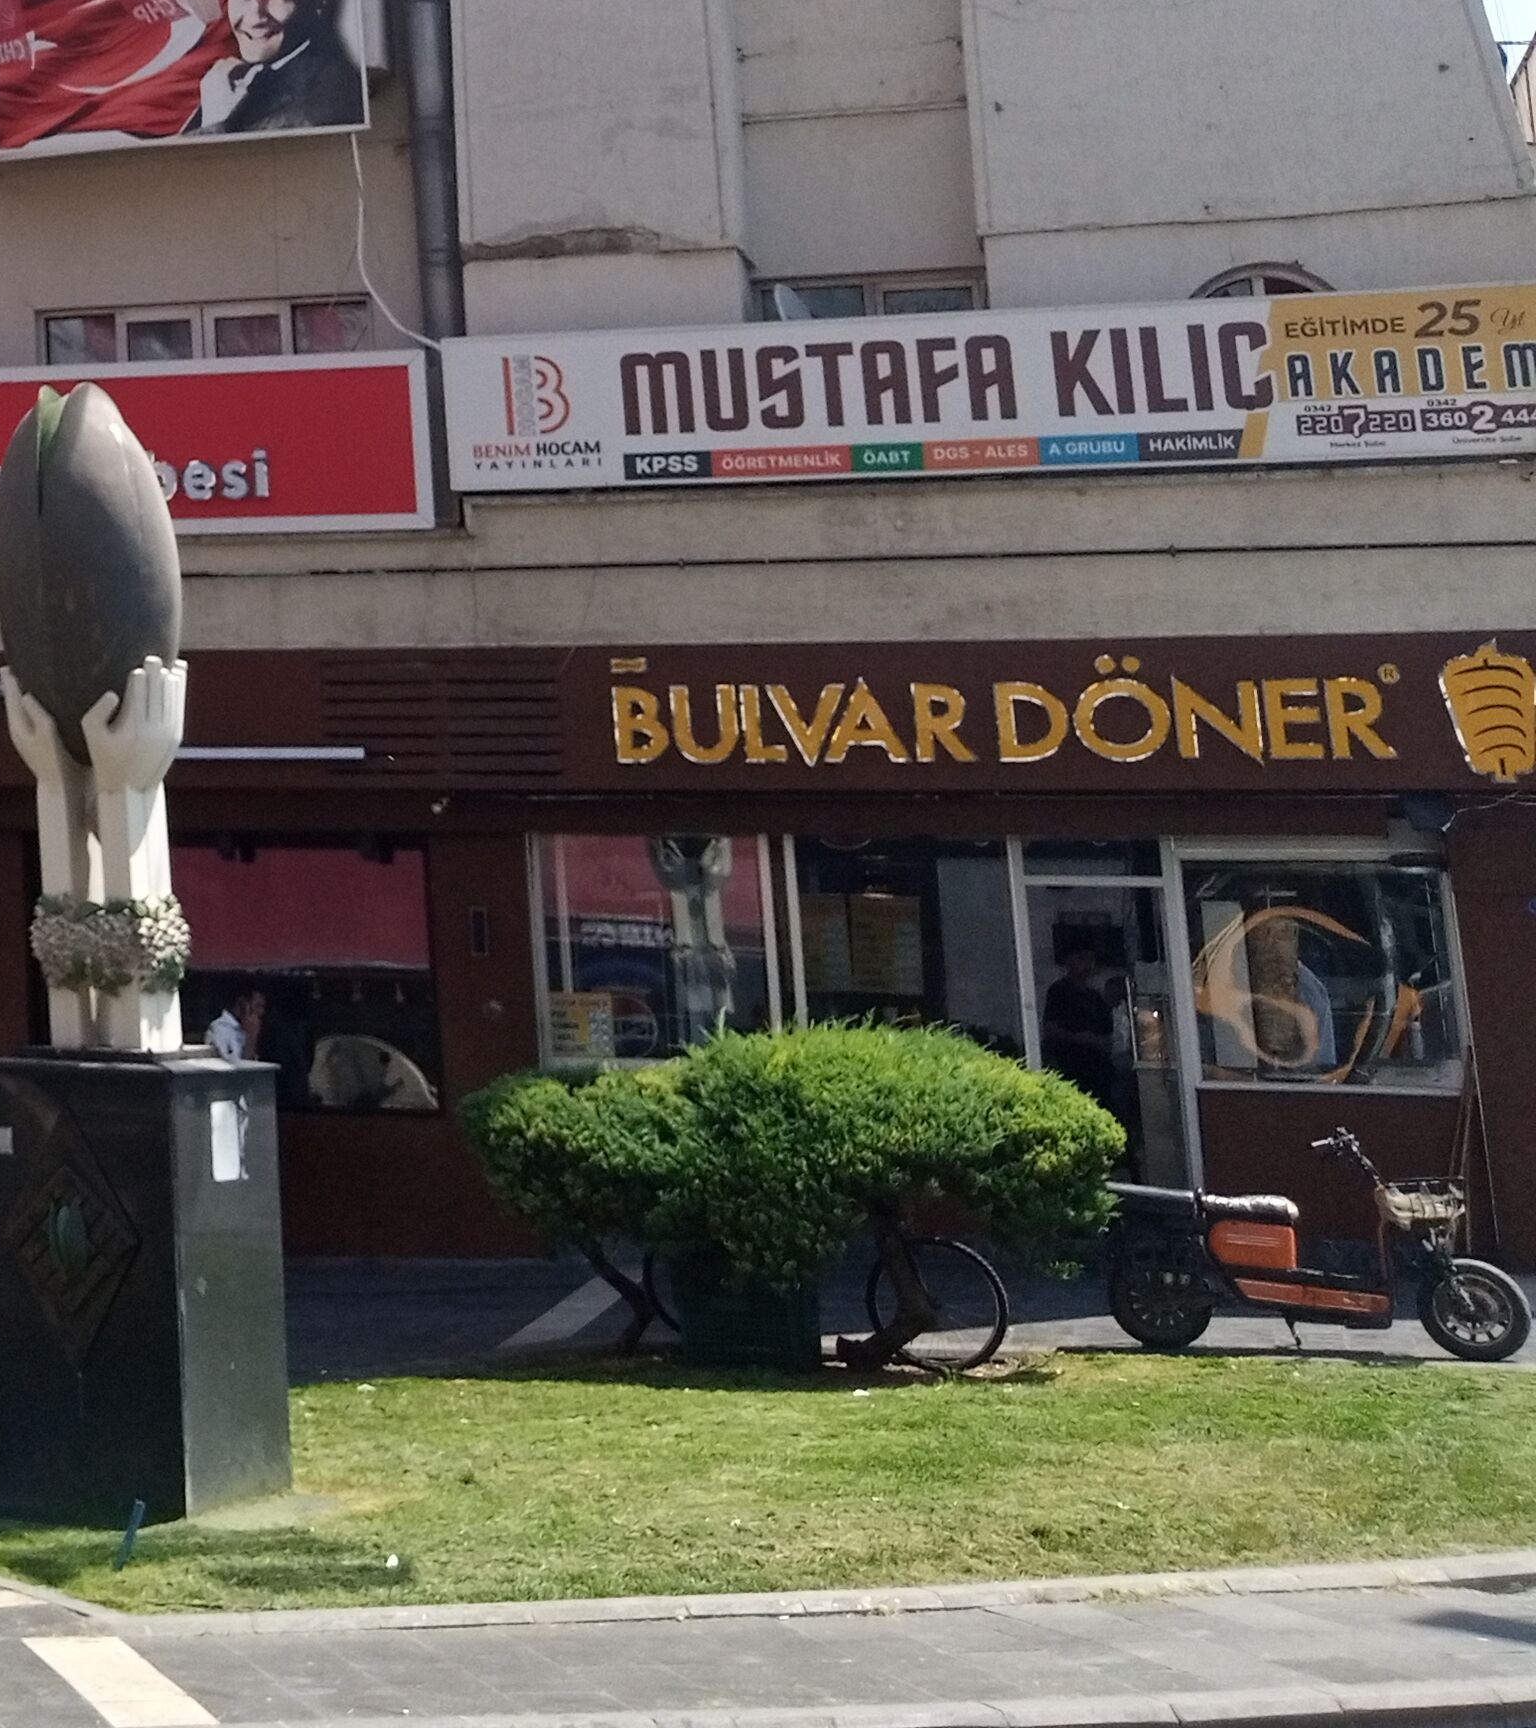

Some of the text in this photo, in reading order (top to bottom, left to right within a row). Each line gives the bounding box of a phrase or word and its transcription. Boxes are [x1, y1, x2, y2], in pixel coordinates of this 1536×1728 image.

[1284, 314, 1406, 340] EĞİTİMDE
[1414, 298, 1483, 339] 25
[619, 334, 1018, 437] MUSTAFA
[536, 440, 602, 457] HOCAM
[933, 445, 970, 462] DGS
[985, 442, 1029, 460] ALES
[1049, 437, 1126, 457] A GRUBU
[1149, 431, 1237, 454] HAKİMLİK
[634, 453, 699, 475] KPSS
[721, 447, 842, 471] ÖĞRETMENLİK
[863, 446, 911, 466] ÖABT
[148, 448, 270, 501] besi
[611, 654, 1398, 767] BULVAR DÖNER
